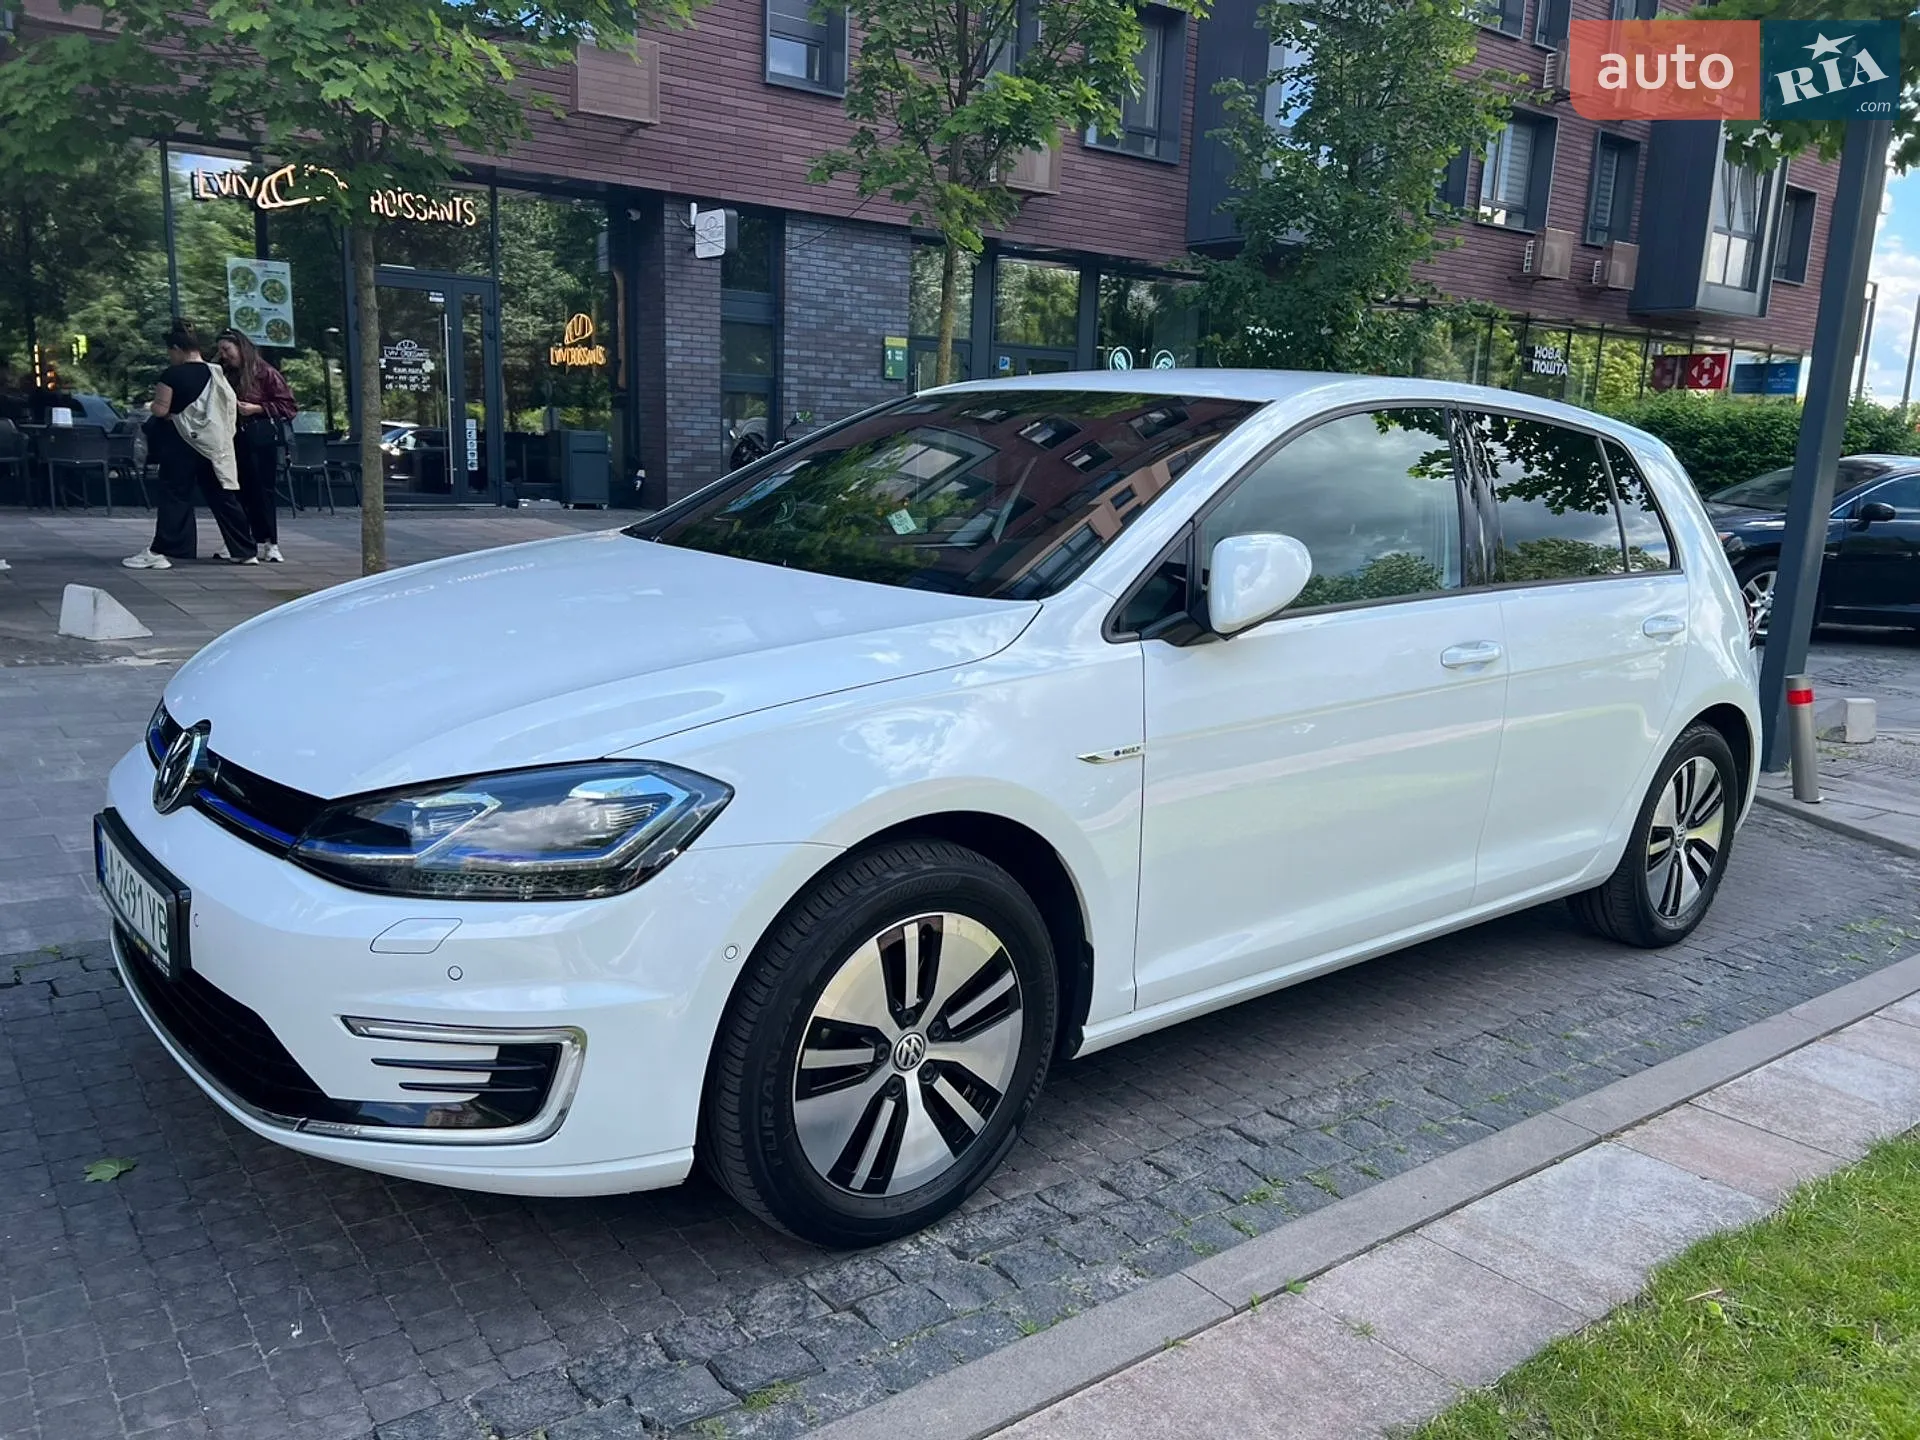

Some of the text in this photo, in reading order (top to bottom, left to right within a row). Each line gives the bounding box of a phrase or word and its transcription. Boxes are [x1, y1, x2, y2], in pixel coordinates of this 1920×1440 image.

[369, 186, 477, 227] ROISSANTS
[1532, 359, 1568, 376] ПОШТА
[1534, 345, 1562, 361] НОВА
[117, 859, 146, 931] 2491
[146, 891, 168, 953] YB
